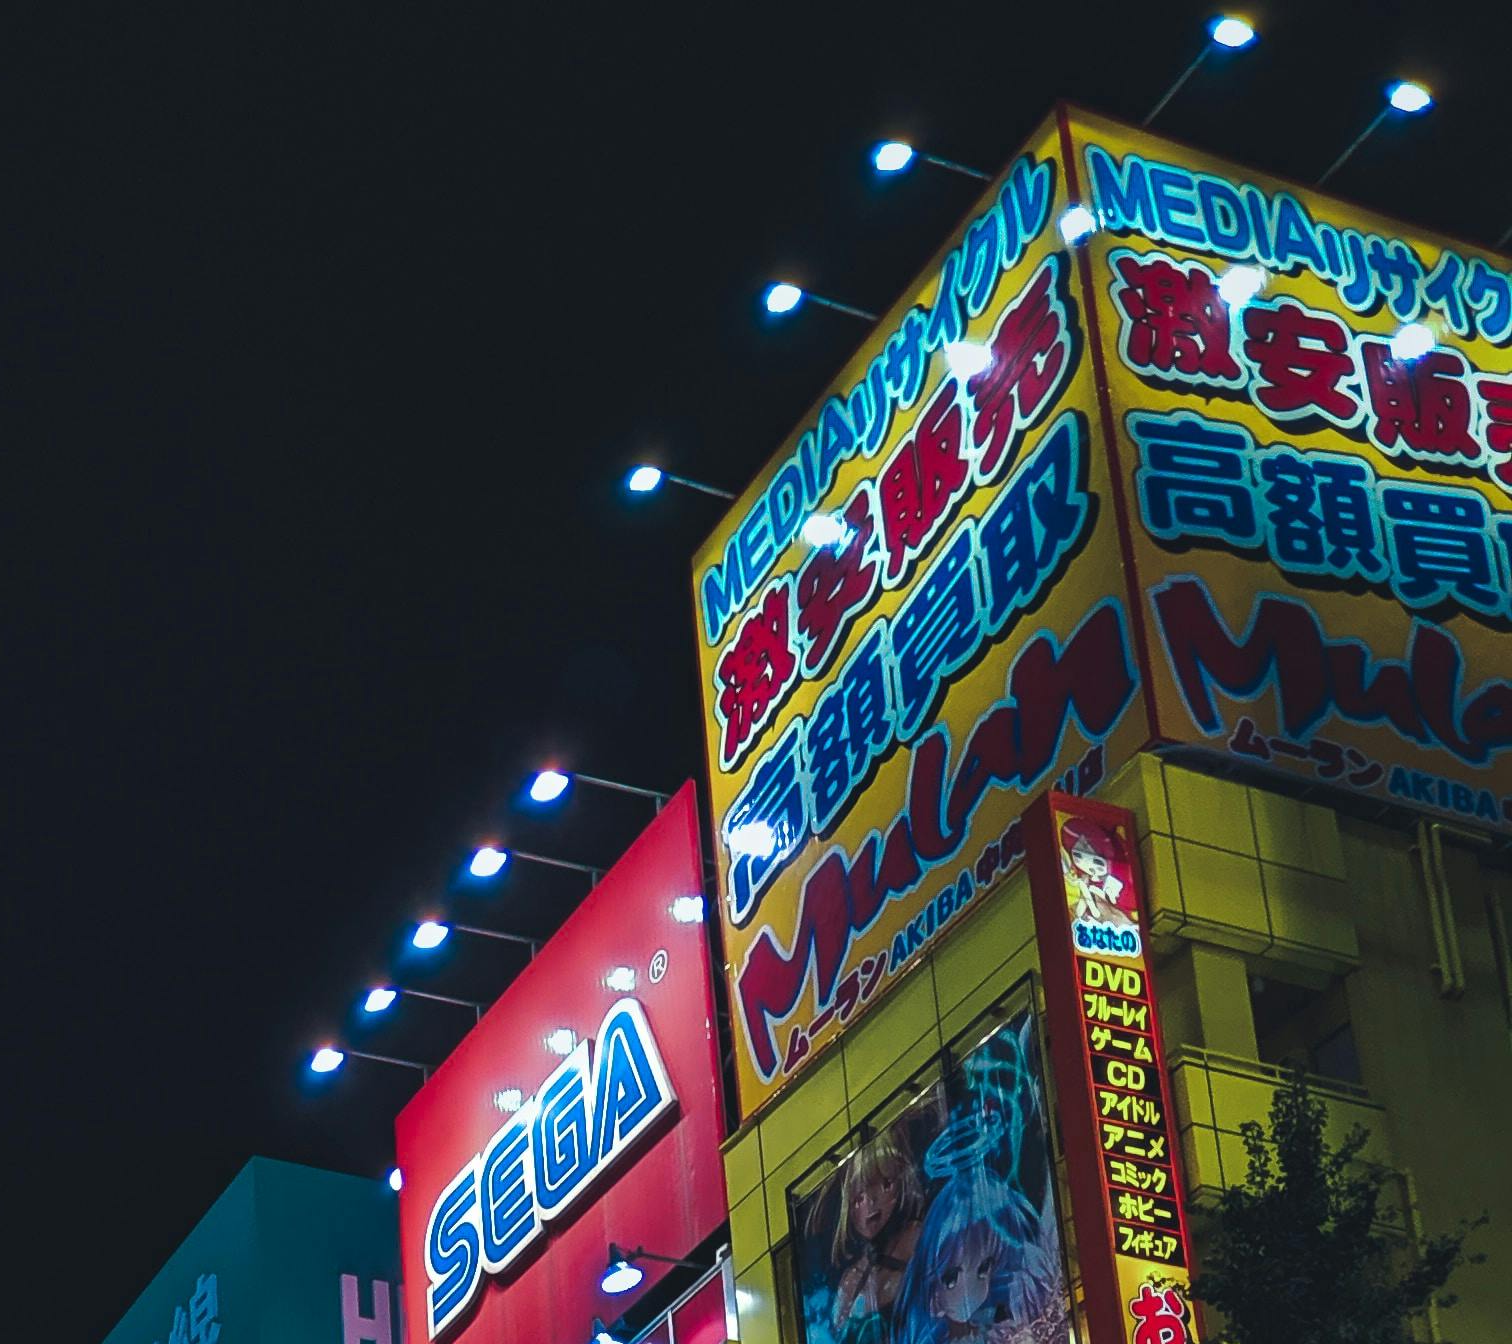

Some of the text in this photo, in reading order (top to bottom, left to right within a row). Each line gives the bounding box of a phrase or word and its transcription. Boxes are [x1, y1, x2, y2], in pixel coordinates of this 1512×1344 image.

[700, 155, 1053, 640] MEDIAリサイクル
[714, 255, 1075, 772] 激安販売
[1128, 410, 1512, 616] 高額買
[724, 412, 1090, 925] 高額買取
[1229, 716, 1385, 788] ムーラン
[1389, 766, 1503, 824] AKIBA
[738, 597, 1143, 1085] Mulan
[1076, 922, 1138, 953] あなたの
[783, 952, 888, 1074] ムーラン
[890, 869, 976, 974] AKIBA
[1085, 960, 1141, 996] DVD
[1091, 1026, 1153, 1063] ゲーム
[1107, 1060, 1146, 1091] CD
[1099, 1091, 1161, 1126] アイドル
[1103, 1124, 1165, 1159] アニメ
[425, 997, 678, 1344] SEGA
[1110, 1160, 1167, 1194] コミック
[1118, 1192, 1172, 1223] ホビー
[1118, 1226, 1178, 1260] フィギュア
